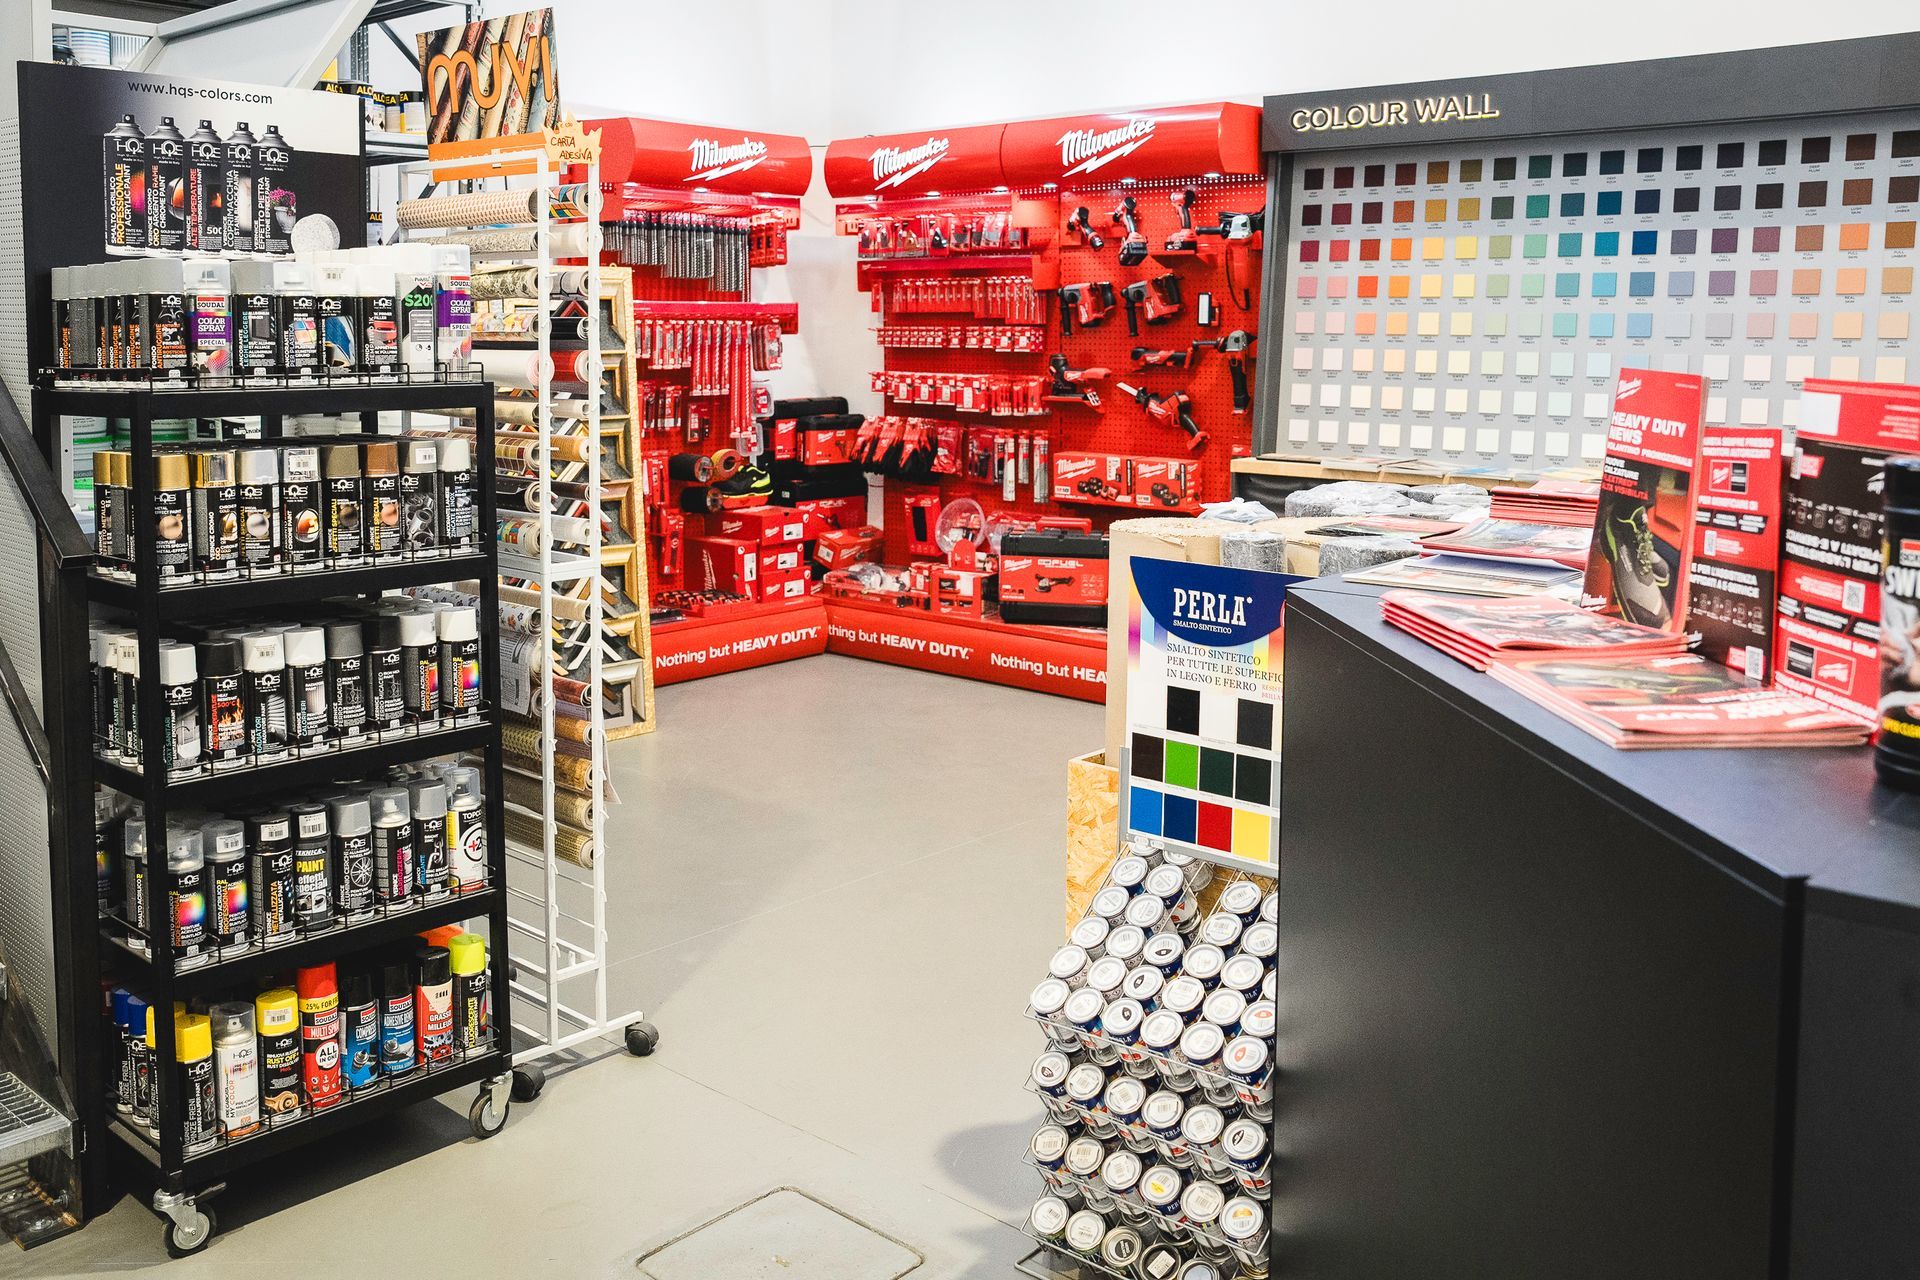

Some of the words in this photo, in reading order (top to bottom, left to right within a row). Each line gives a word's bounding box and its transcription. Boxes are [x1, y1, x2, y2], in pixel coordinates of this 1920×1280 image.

[127, 82, 273, 105] www.hqs-colors.com
[1290, 101, 1408, 132] COLOUR
[1413, 93, 1500, 123] WALL
[550, 136, 576, 148] CARTA
[1055, 117, 1157, 166] Milwaukee
[259, 148, 289, 164] HQS
[687, 137, 768, 171] Milwaukee
[868, 137, 950, 181] Milwaukee
[115, 163, 125, 244] PROFESSIONALE
[190, 168, 198, 228] TEMPERATURE
[226, 169, 234, 248] COPRIMACCHIA
[160, 295, 182, 305] HQS
[247, 295, 269, 305] HQS
[293, 296, 313, 307] HQS
[317, 298, 342, 310] HQS
[373, 297, 393, 308] HQS
[197, 317, 226, 325] COLOR
[197, 324, 226, 332] SPRAY
[1611, 411, 1651, 432] HEAVY
[1651, 418, 1687, 438] DUTY
[1608, 426, 1643, 445] NEWS
[1055, 456, 1097, 475] Milwaukee
[331, 479, 354, 490] HQS
[373, 477, 395, 489] HQS
[239, 486, 263, 498] HQS
[283, 484, 309, 498] HQS
[154, 492, 177, 504] HQS
[1172, 587, 1247, 627] PERLA
[1172, 619, 1198, 630] SMALTO
[1198, 621, 1232, 635] SINTETICO
[858, 629, 879, 644] but
[880, 632, 926, 653] HEAVY
[462, 643, 478, 653] HQS
[655, 647, 708, 669] Nothing
[709, 643, 731, 660] but
[732, 634, 779, 656] HEAVY
[1166, 642, 1206, 658] SMALTO
[1207, 648, 1261, 666] SINTETICO
[341, 659, 361, 669] HQS
[382, 653, 400, 664] HQS
[990, 651, 1044, 675] Nothing
[1046, 660, 1070, 678] but
[1167, 655, 1185, 668] PER
[1187, 659, 1219, 673] TUTTE
[1220, 664, 1233, 675] LE
[304, 667, 324, 677] HQS
[216, 679, 238, 690] HQS
[254, 674, 281, 687] HQS
[1166, 668, 1177, 678] IN
[1179, 670, 1212, 685] LEGNO
[1214, 675, 1221, 685] E
[1223, 678, 1257, 692] FERRO
[164, 686, 193, 699] HQS
[424, 820, 443, 830] HQS
[344, 838, 367, 849] HQS
[226, 863, 245, 873] HQS
[296, 859, 325, 873] PAINT
[178, 874, 200, 886] HQS
[306, 1002, 320, 1010] 25%
[321, 1000, 333, 1008] FOR
[275, 1038, 293, 1048] HQS
[319, 1045, 338, 1057] ALL
[327, 1054, 338, 1062] ONE
[188, 1060, 213, 1077] HQS
